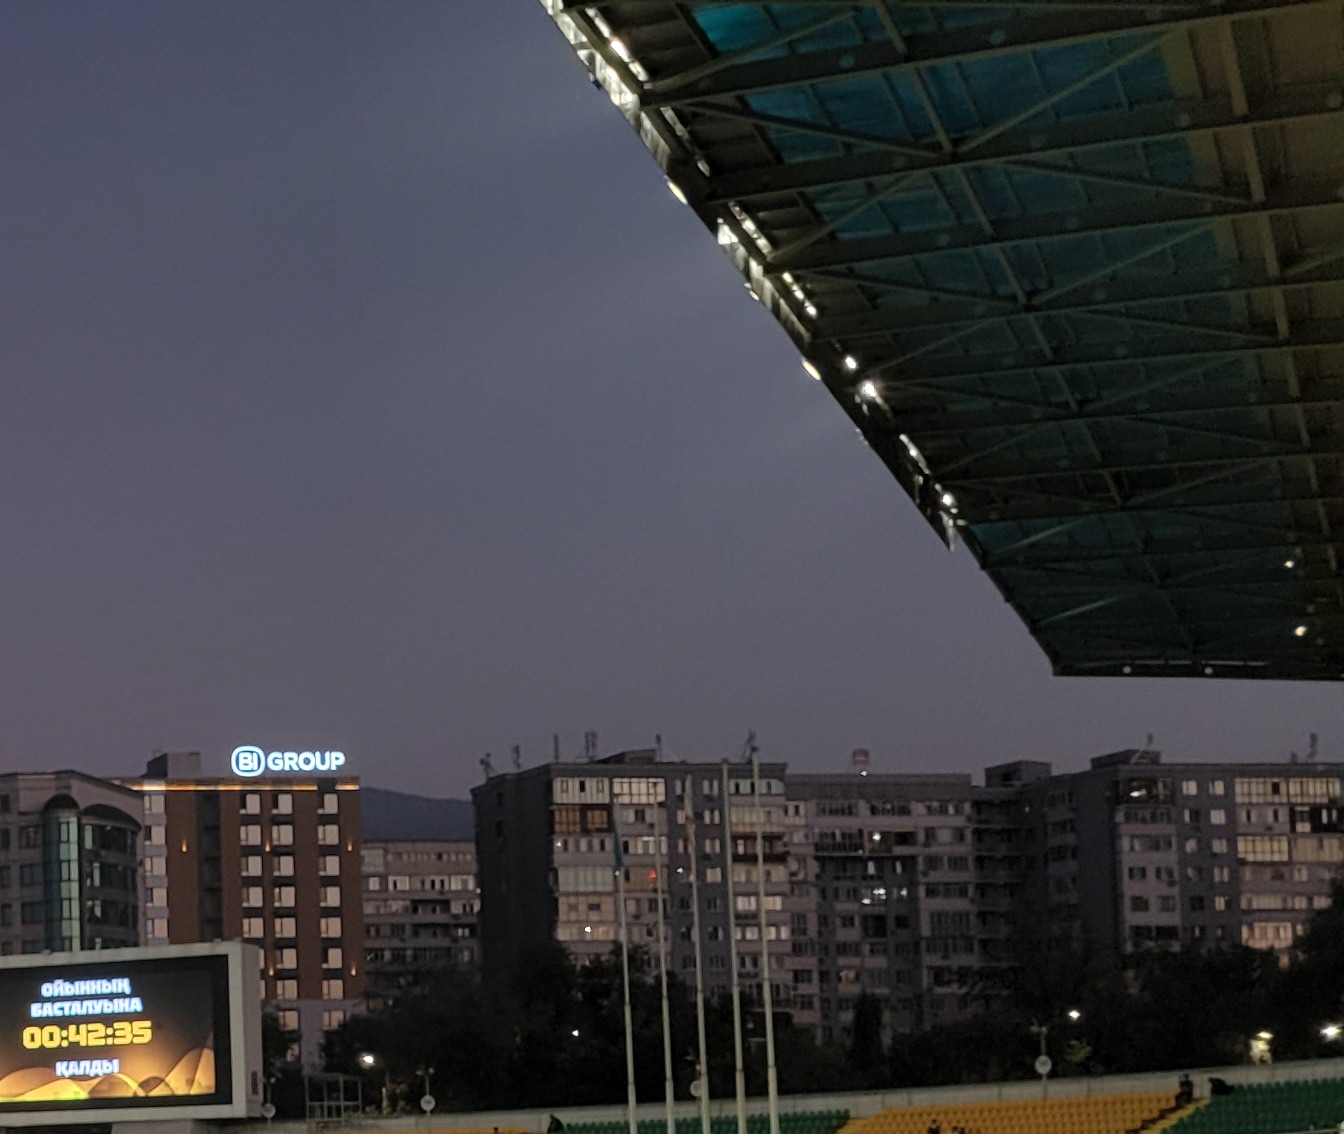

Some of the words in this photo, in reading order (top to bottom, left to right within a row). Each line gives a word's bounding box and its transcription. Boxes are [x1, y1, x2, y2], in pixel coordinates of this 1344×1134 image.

[238, 751, 259, 771] BI
[266, 750, 346, 771] GROUP
[40, 978, 132, 997] ОЙЫННЫҢ
[30, 997, 143, 1018] БАСТАЛУЫНА
[22, 1020, 153, 1049] 00:42:35
[55, 1058, 120, 1078] ҚАЛДЫ
